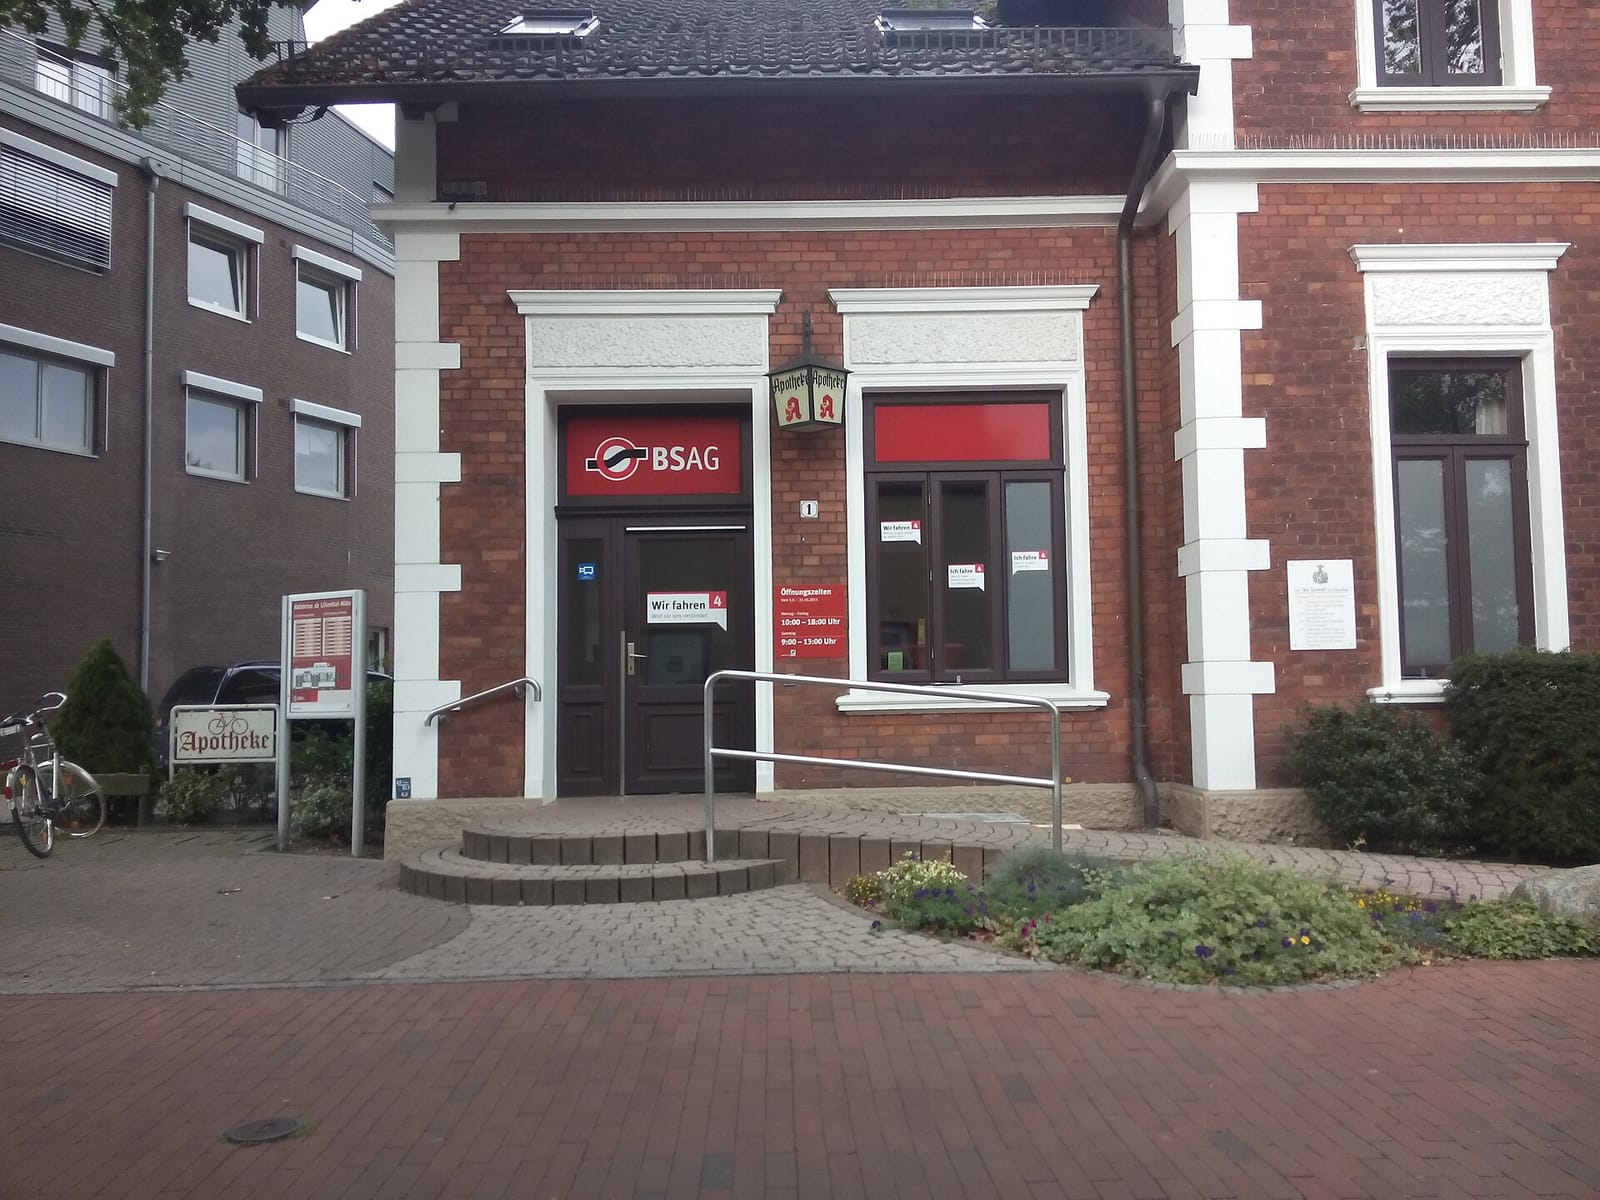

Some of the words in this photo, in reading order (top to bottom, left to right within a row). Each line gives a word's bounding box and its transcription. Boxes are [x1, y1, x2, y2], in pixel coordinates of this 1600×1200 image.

[813, 370, 844, 390] Apotheke
[785, 396, 802, 422] A
[820, 394, 835, 420] A
[652, 446, 719, 471] BSAG
[806, 503, 812, 515] 1
[780, 587, 832, 597] Öffnungszeiten
[651, 601, 669, 610] Wir
[672, 600, 706, 610] fahren
[713, 594, 722, 607] 4
[807, 618, 826, 626] 18:00
[781, 638, 797, 646] 9:00
[823, 637, 837, 645] Uhr
[180, 730, 270, 755] Apotheke
